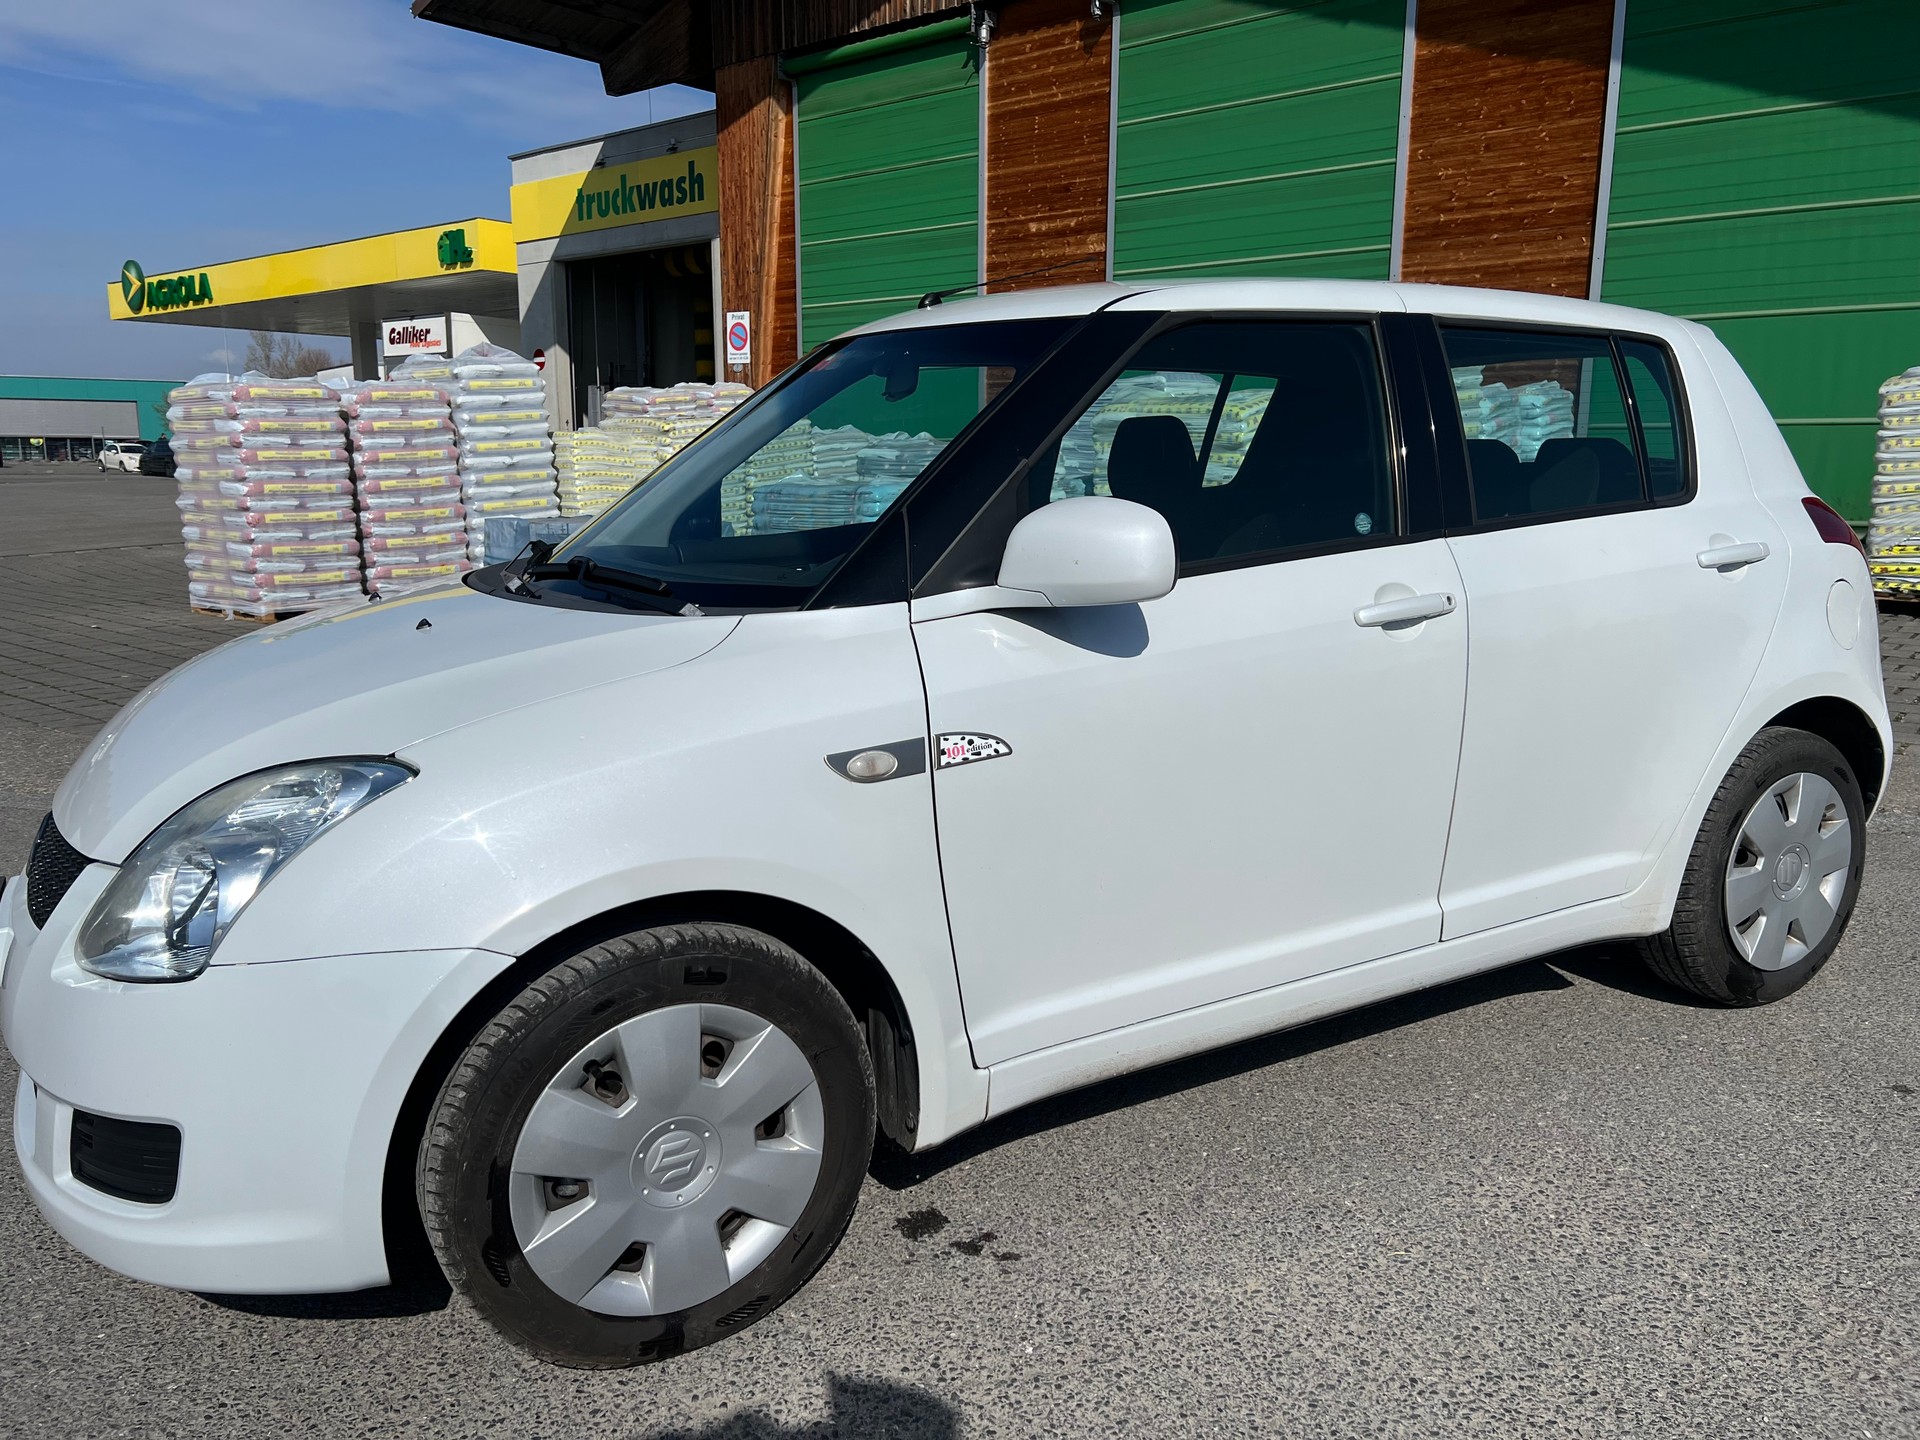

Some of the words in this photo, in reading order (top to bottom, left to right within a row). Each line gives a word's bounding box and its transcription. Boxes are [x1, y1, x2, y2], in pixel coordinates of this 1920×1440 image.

[576, 160, 705, 221] truckwash
[146, 273, 213, 308] AGROLA
[389, 326, 431, 345] Galliker
[946, 745, 966, 758] 101
[966, 742, 993, 753] edition
